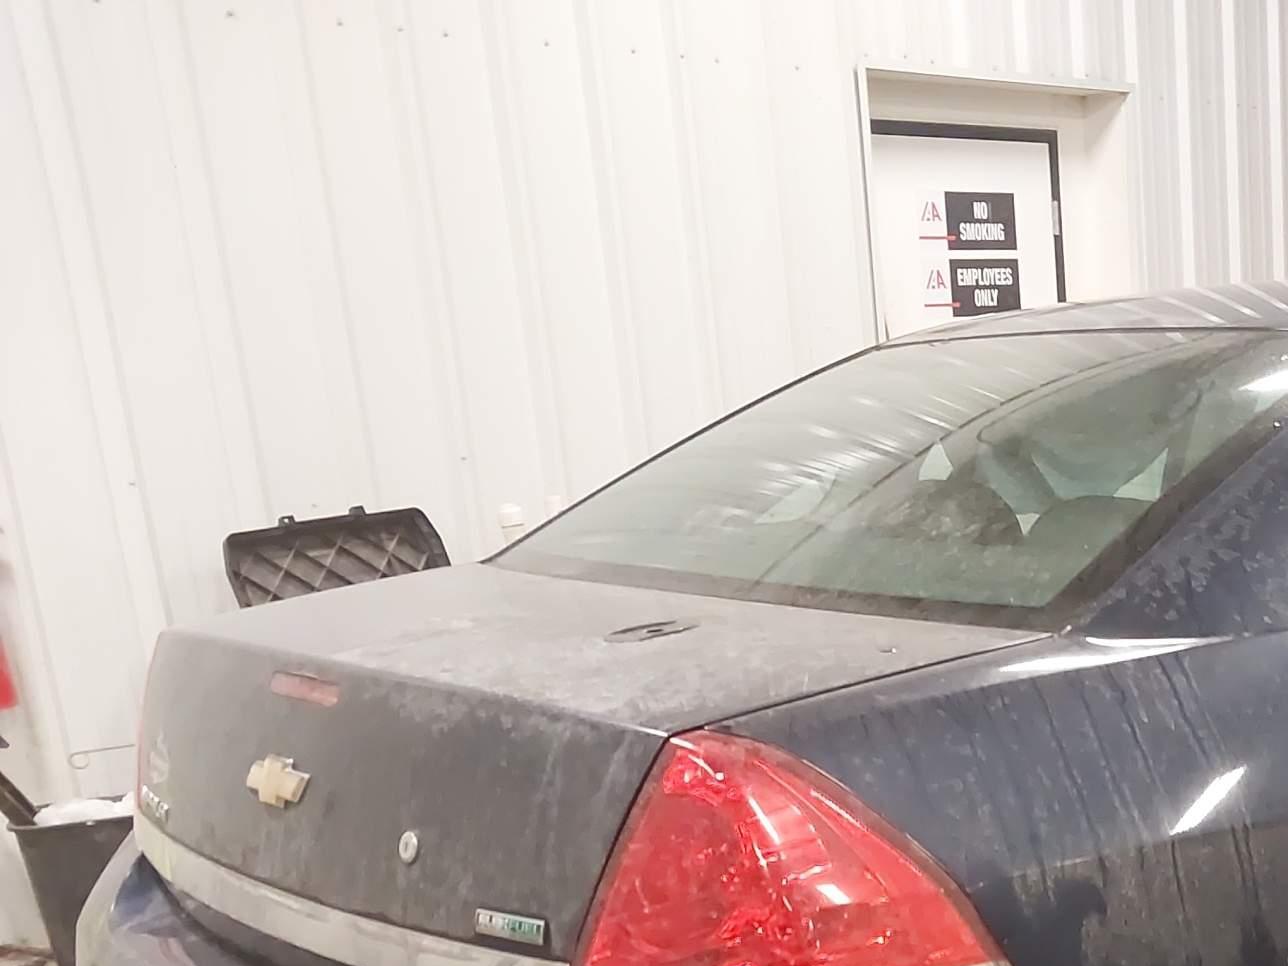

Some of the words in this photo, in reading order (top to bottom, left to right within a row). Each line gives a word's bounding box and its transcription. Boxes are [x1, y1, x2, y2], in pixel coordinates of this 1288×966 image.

[972, 201, 988, 220] NO
[959, 222, 1005, 241] SMOKING
[956, 267, 1013, 286] EMPLOYEES
[974, 288, 999, 307] ONLY
